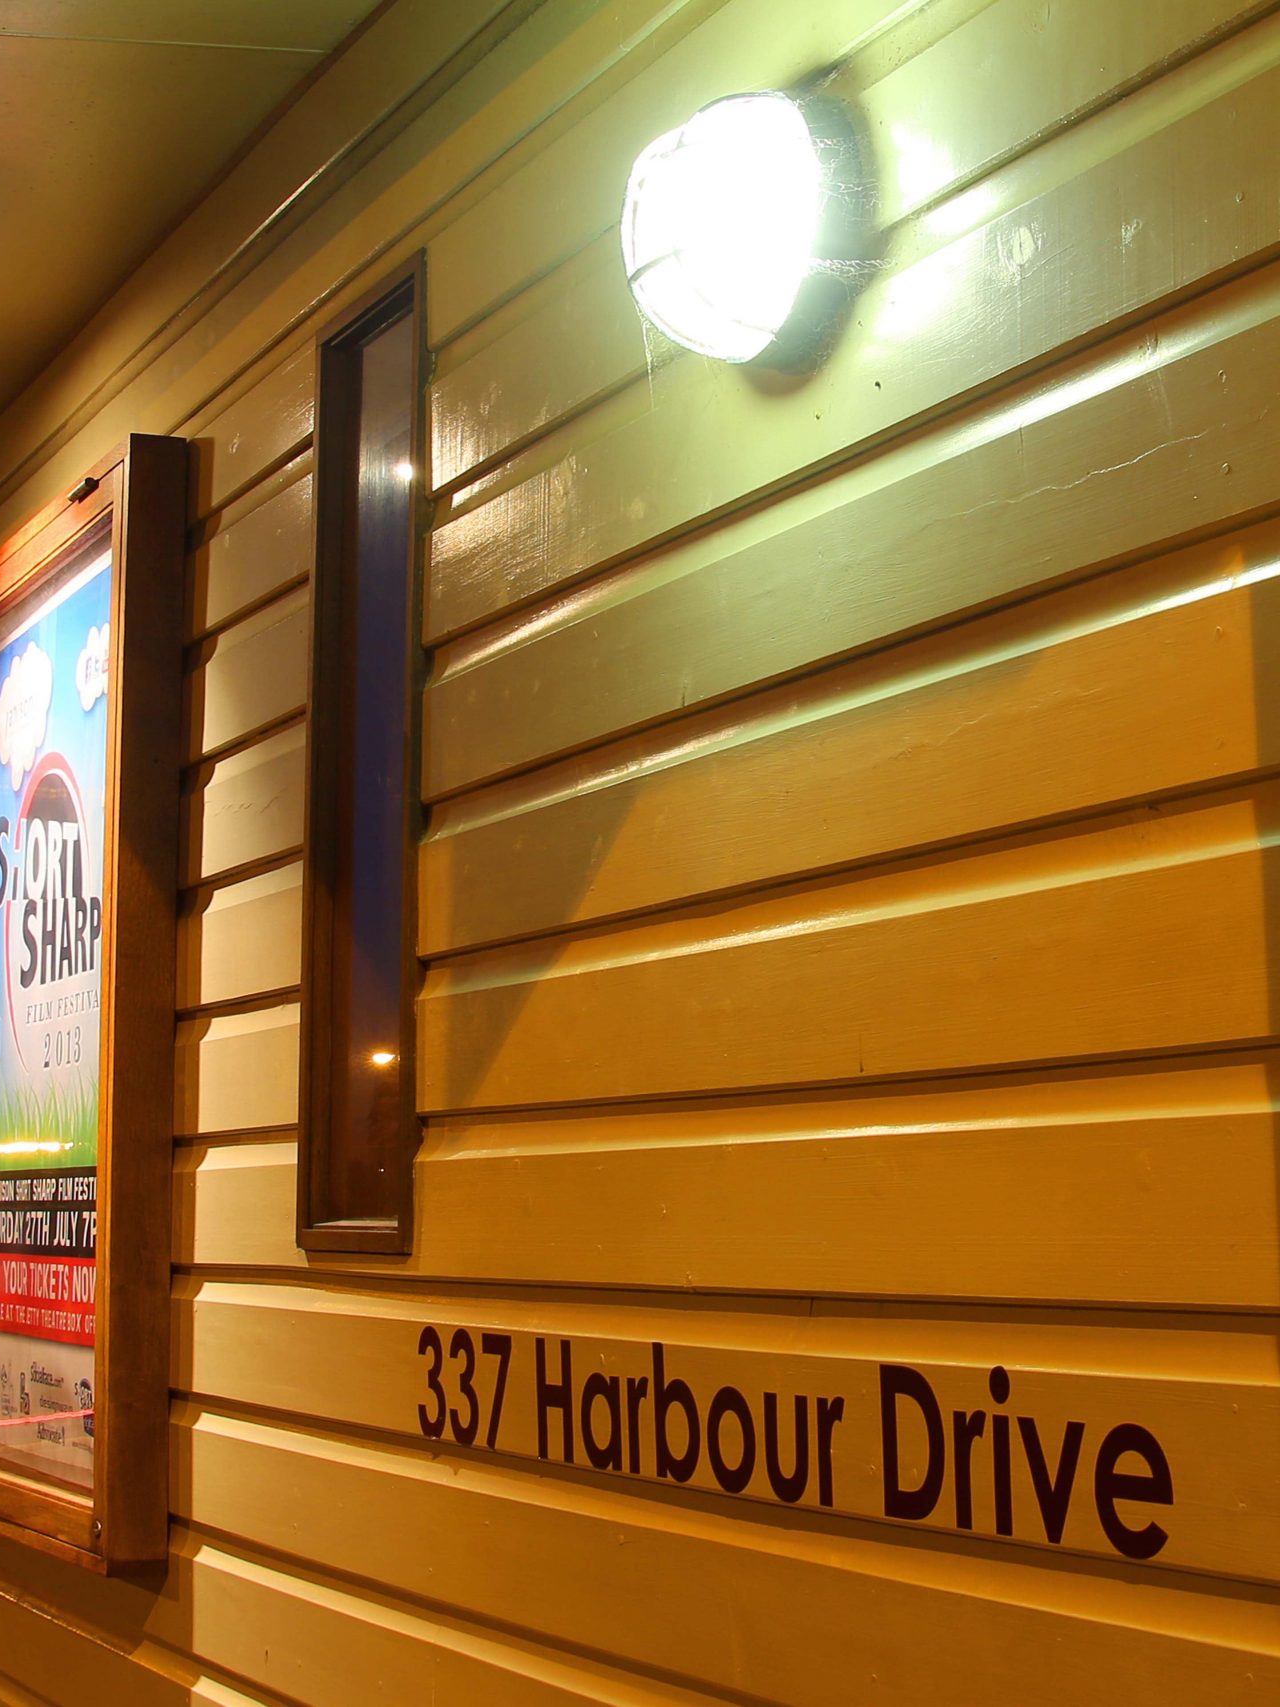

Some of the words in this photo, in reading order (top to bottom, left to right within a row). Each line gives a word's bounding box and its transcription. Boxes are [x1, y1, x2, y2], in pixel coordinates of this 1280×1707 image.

[20, 897, 101, 989] SHARP
[26, 1001, 53, 1024] FILM
[43, 1026, 81, 1068] 2013
[32, 1177, 56, 1201] SHARP
[58, 1177, 73, 1201] FILM
[25, 1211, 50, 1246] 27TH
[53, 1211, 78, 1247] JULY
[3, 1260, 28, 1296] YOUR
[29, 1262, 69, 1302] TICKETS
[5, 1304, 14, 1322] AT
[41, 1309, 66, 1331] THEATRE
[66, 1312, 81, 1334] BOX
[417, 1326, 511, 1450] 337
[535, 1337, 843, 1508] Harbour
[880, 1364, 1174, 1560] Drive
